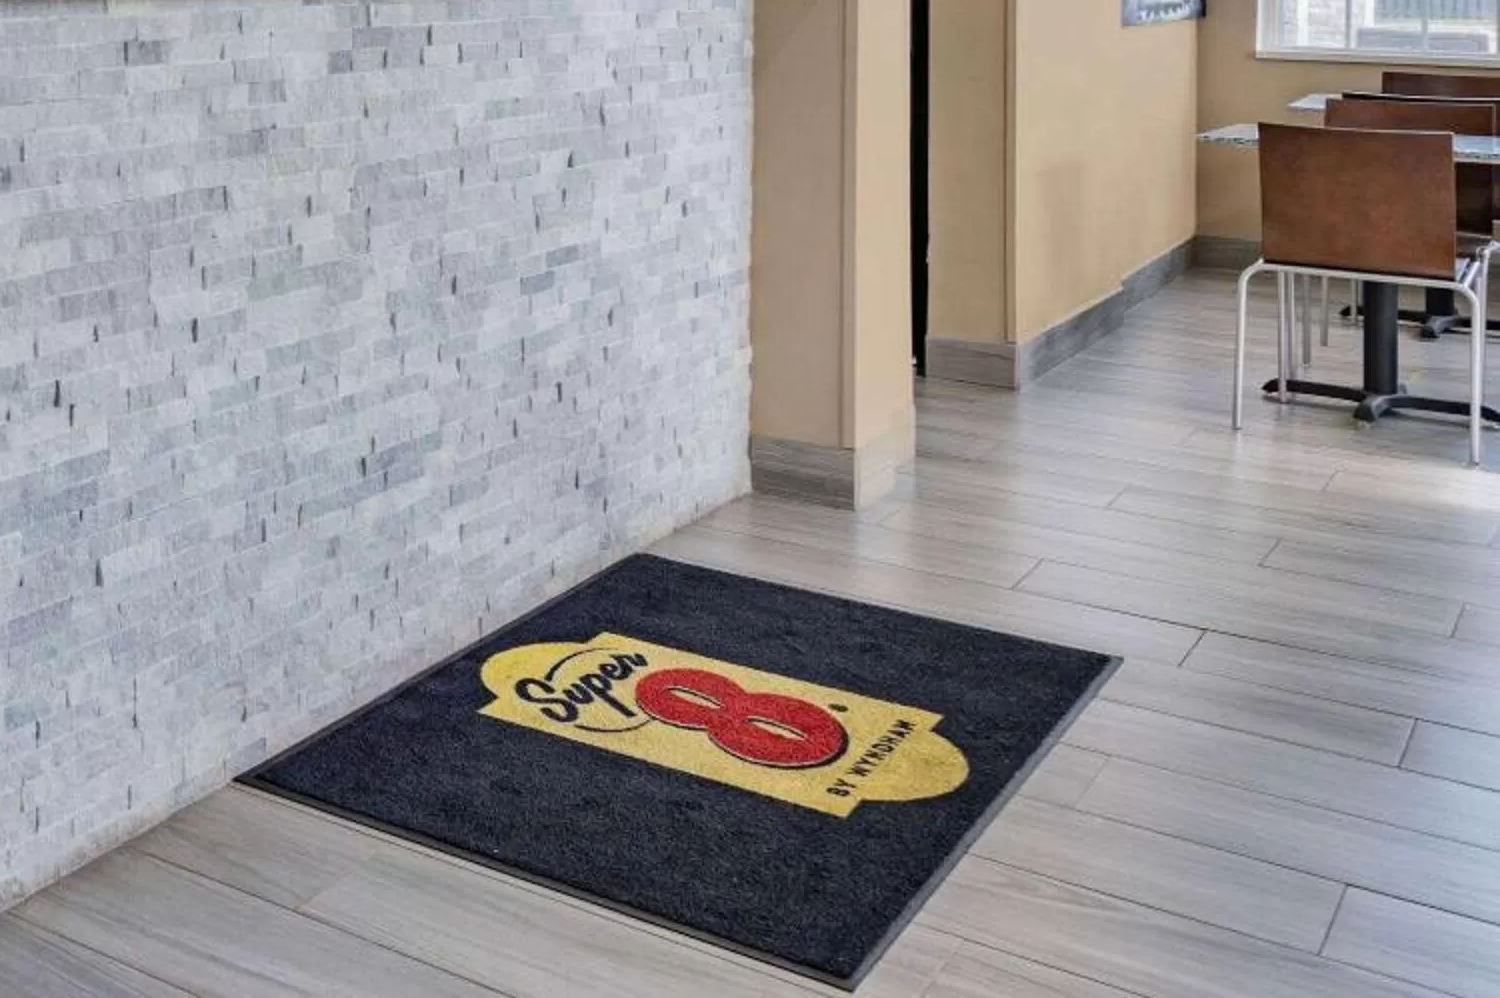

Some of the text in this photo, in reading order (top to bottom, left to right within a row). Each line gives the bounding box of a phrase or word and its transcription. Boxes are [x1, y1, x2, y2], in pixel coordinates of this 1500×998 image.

[514, 652, 849, 770] Super 8
[826, 718, 917, 797] BY WYNDHAM
